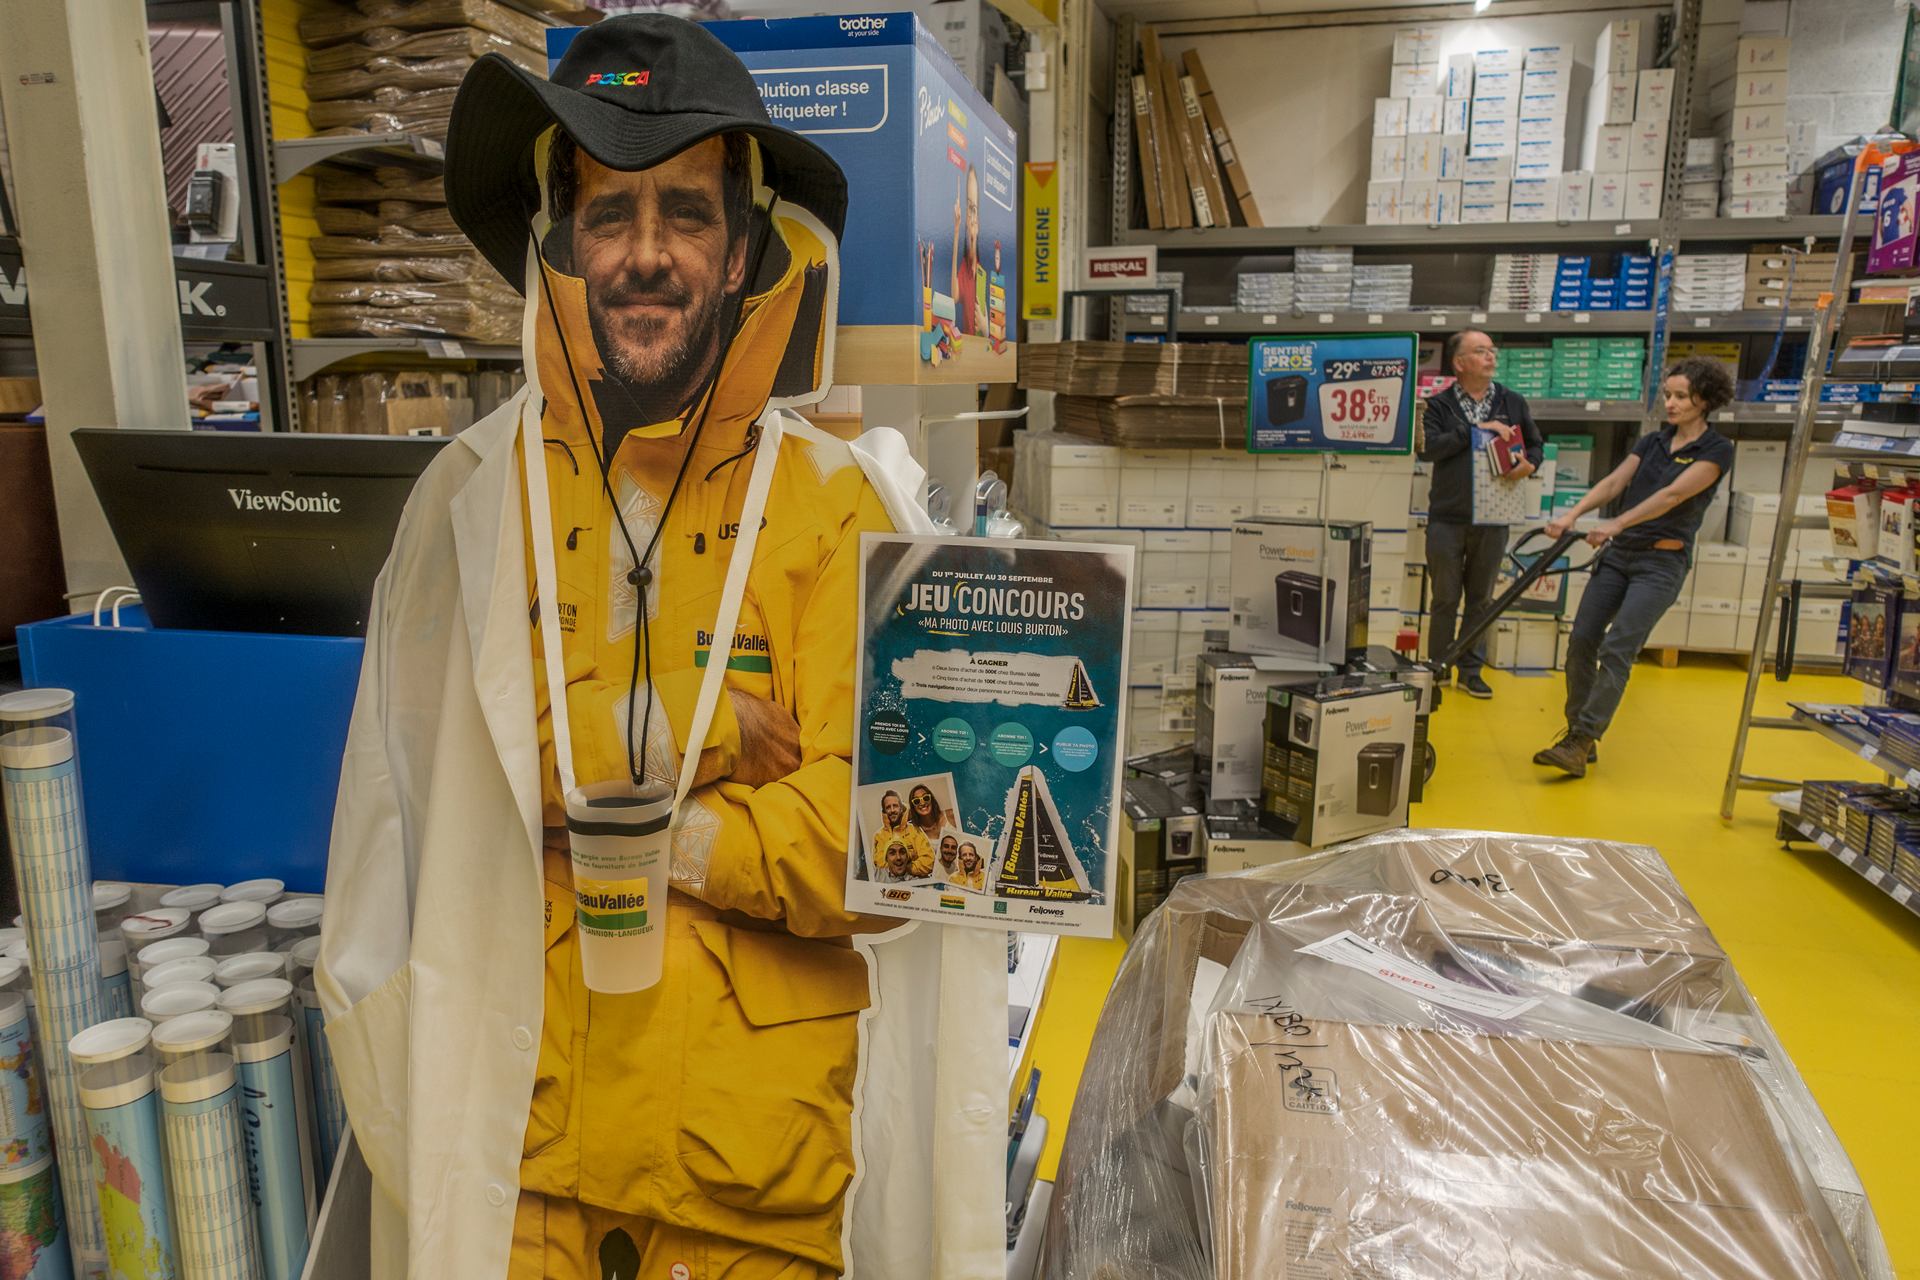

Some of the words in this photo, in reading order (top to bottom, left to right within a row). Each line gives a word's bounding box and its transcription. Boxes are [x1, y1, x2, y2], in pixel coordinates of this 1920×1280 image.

[840, 16, 888, 30] brother
[585, 70, 650, 86] POSCA
[816, 80, 870, 96] classe
[1036, 207, 1050, 283] HYGIENE
[1094, 261, 1144, 272] RESKAL
[1264, 345, 1312, 356] RENTRÉE
[1268, 355, 1312, 368] PROS
[228, 488, 340, 513] ViewSonic
[1008, 576, 1053, 584] SEPTEMBRE
[906, 584, 950, 612] JEU
[958, 586, 1085, 620] CONCOURS
[940, 618, 968, 630] PHOTO
[972, 620, 994, 632] AVEC
[996, 621, 1022, 634] LOUIS
[1025, 623, 1068, 636] BURTON»
[970, 657, 976, 665] À
[978, 659, 1008, 667] GAGNER
[1004, 831, 1022, 873] Bureau
[1015, 790, 1029, 829] Vallée
[1213, 845, 1245, 853] Fellowes
[888, 890, 909, 900] BIC
[1006, 887, 1039, 896] Bureau
[1045, 888, 1072, 898] Vallée
[1029, 906, 1064, 916] Fellowes
[1378, 968, 1436, 990] SPEED
[1285, 1200, 1332, 1214] Fellowes
